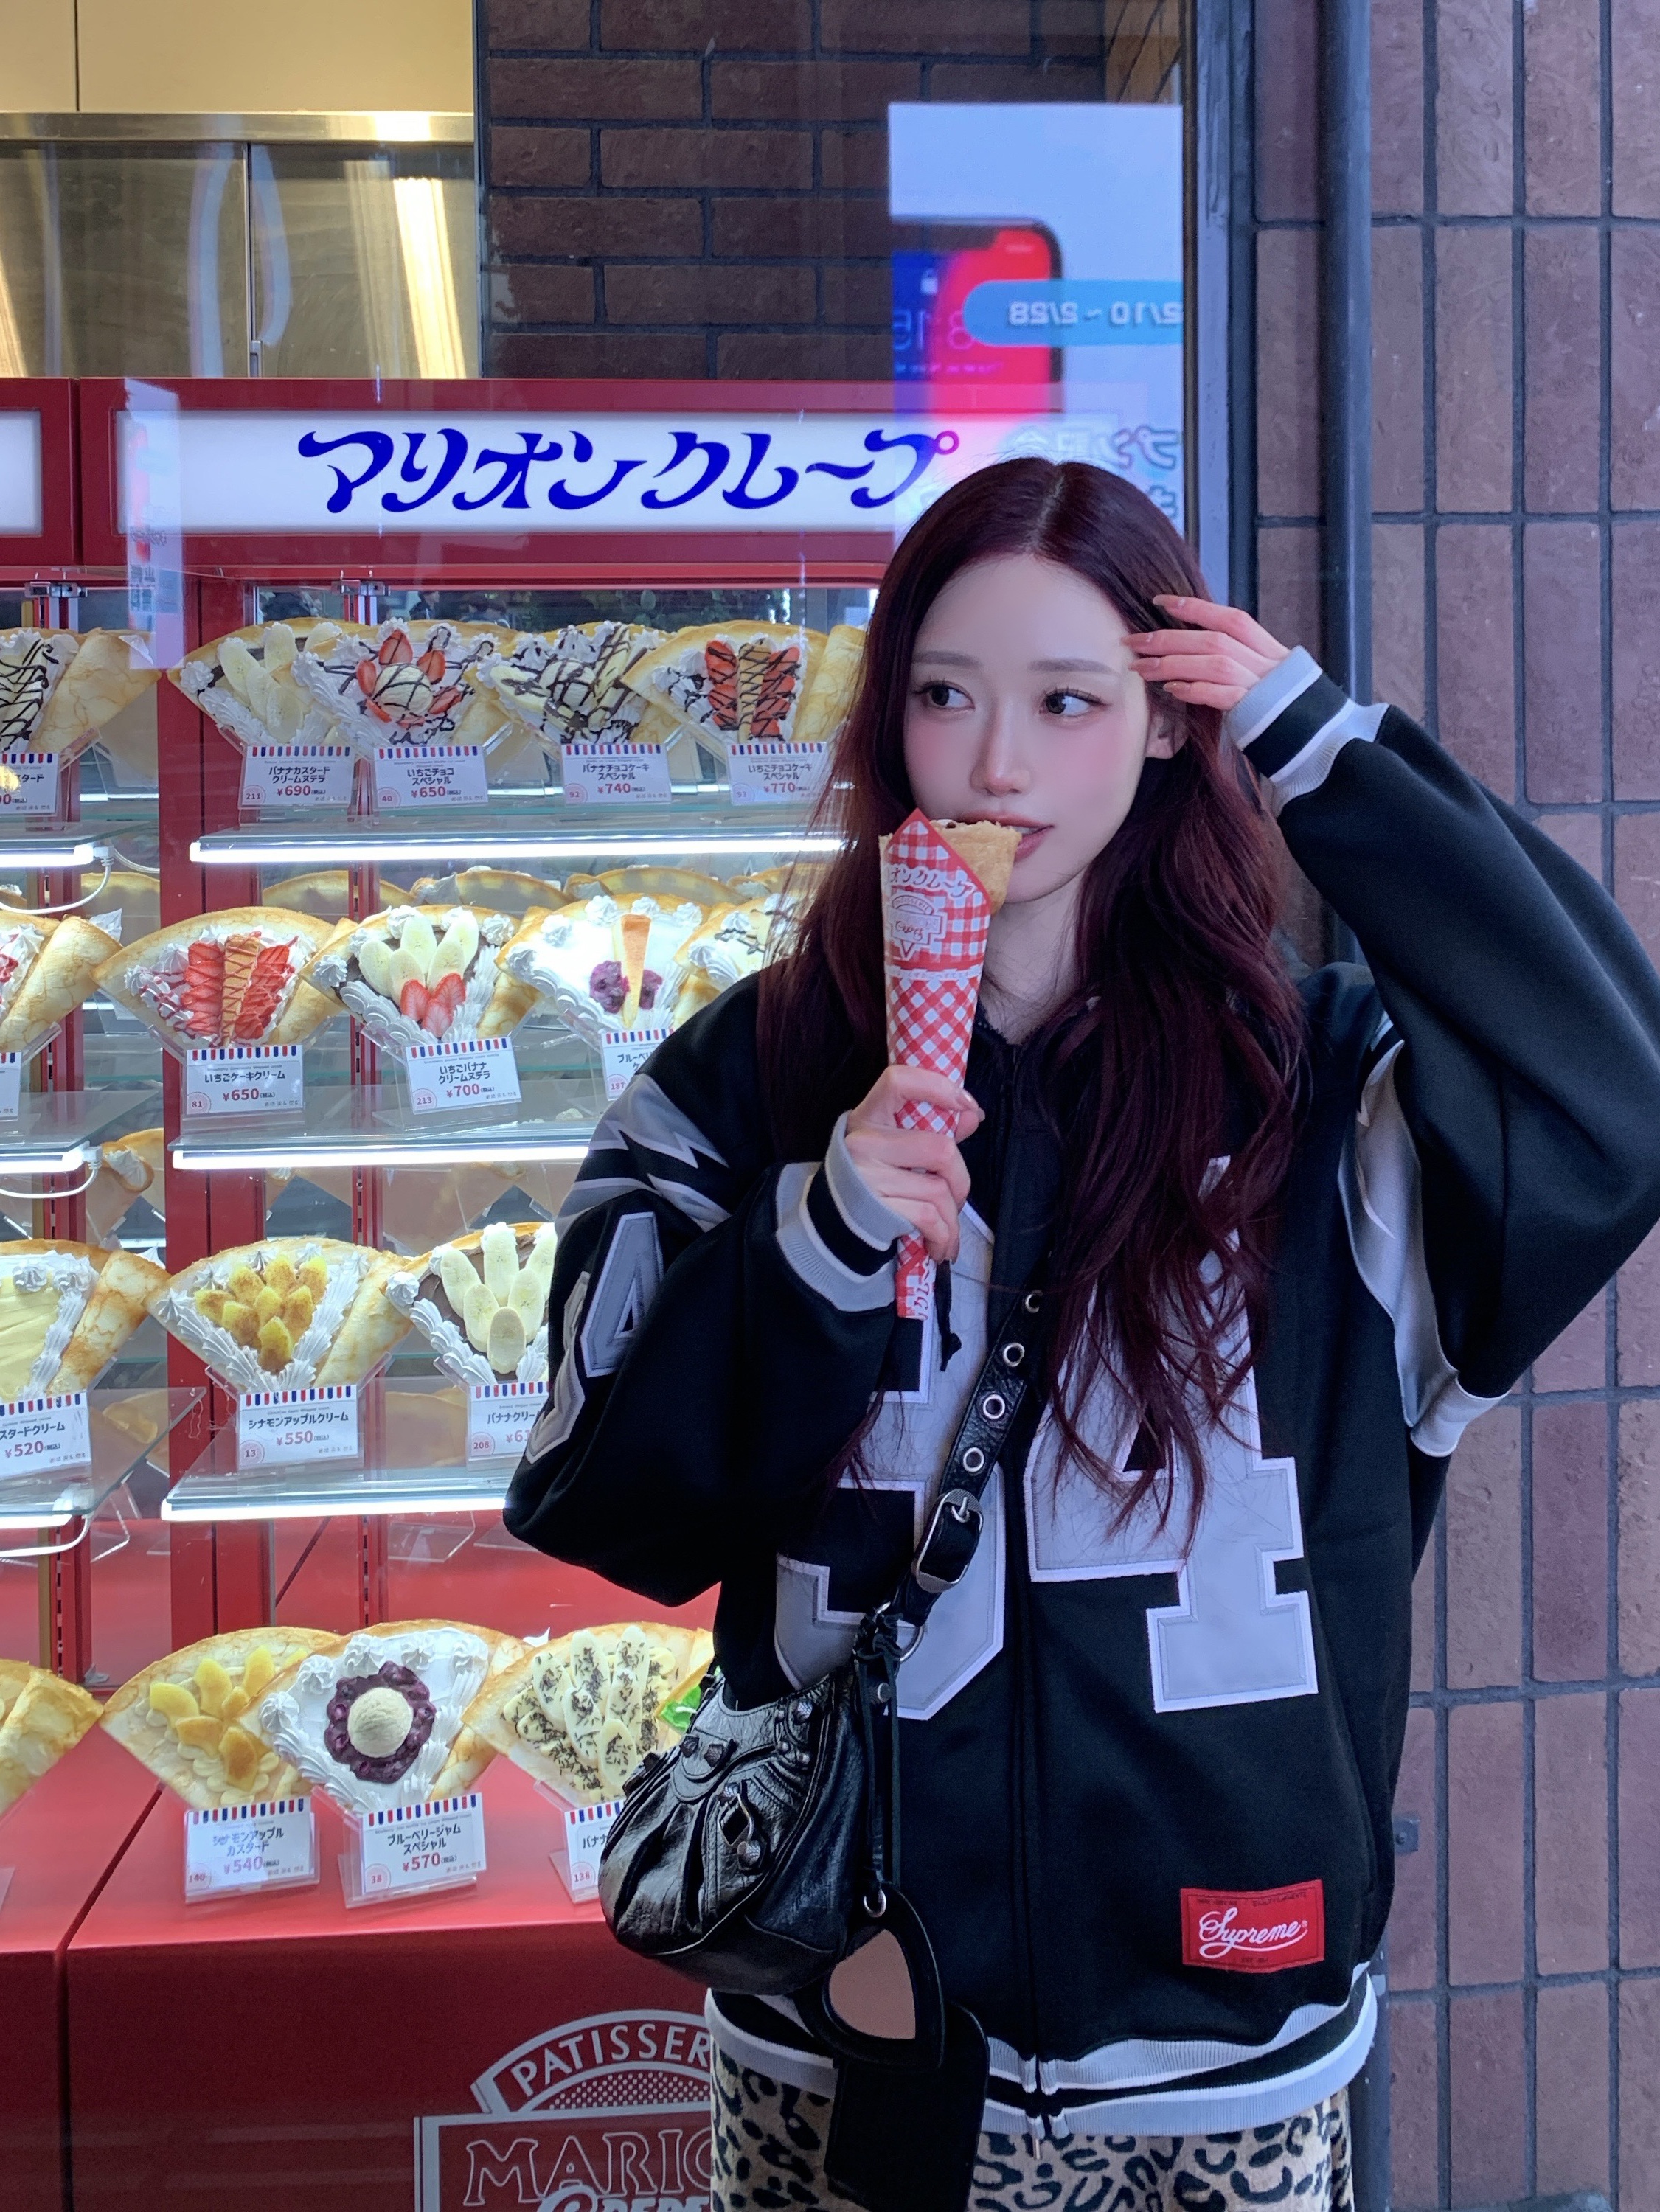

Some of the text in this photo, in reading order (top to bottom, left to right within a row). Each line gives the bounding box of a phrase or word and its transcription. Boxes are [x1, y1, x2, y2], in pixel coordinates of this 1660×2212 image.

[297, 428, 960, 513] マリオンクレープ
[268, 766, 330, 776] バナナカスタード
[407, 768, 454, 777] いちごチョコ
[583, 763, 650, 773] バナナチョコケーキ
[17, 773, 44, 783] タード
[272, 775, 326, 784] クリームヌテラ
[411, 776, 452, 786] スペシャル
[598, 773, 636, 781] スペシャル
[763, 773, 800, 781] スペシャル
[277, 785, 311, 796] ¥690
[411, 786, 446, 798] ¥650
[597, 783, 631, 794] ¥740
[439, 1061, 487, 1075] いちごバナナ
[204, 1070, 285, 1083] いちごケーキクリーム
[438, 1070, 491, 1085] クリームヌテラ
[223, 1088, 260, 1101] ¥650
[445, 1084, 480, 1098] ¥700
[416, 1096, 432, 1105] 213
[249, 1411, 349, 1430] シナモンアップルクリーム
[276, 1430, 313, 1446] ¥550
[5, 1440, 44, 1458] ¥520
[473, 1441, 490, 1450] 208
[245, 1449, 256, 1458] 13
[387, 1823, 462, 1846] ブルーベリージャム
[403, 1837, 447, 1856] スペシャル
[223, 1856, 263, 1874] ¥540
[403, 1852, 441, 1872] ¥570
[371, 1874, 383, 1884] 38
[1199, 1907, 1308, 1959] Supreme
[510, 2023, 712, 2097] PATISSER
